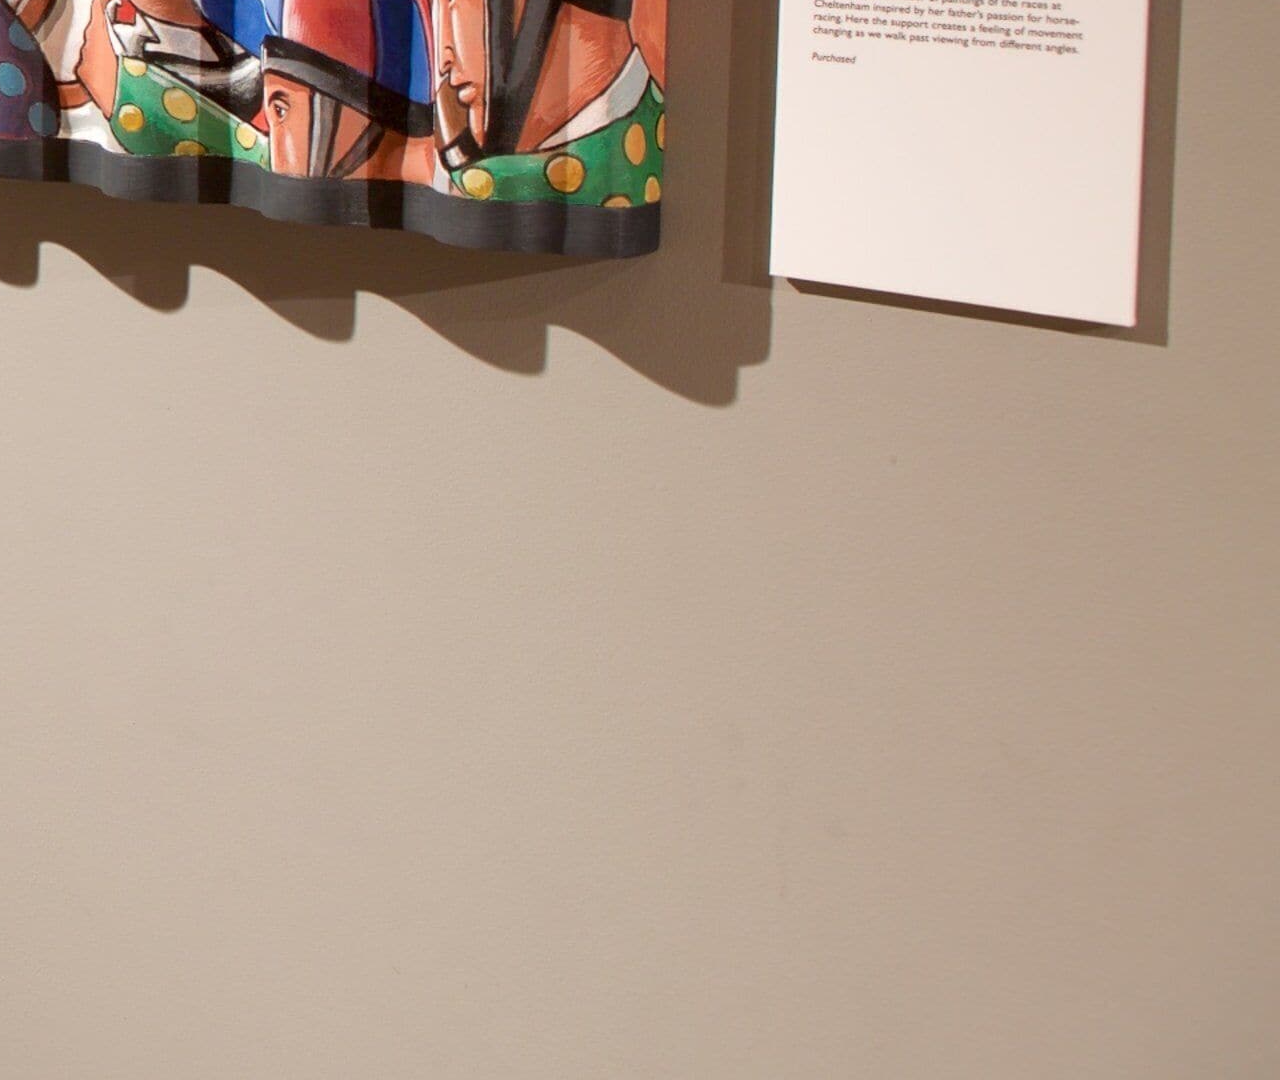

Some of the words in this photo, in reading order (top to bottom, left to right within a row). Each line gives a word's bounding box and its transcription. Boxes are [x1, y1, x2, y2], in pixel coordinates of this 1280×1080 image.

[814, 0, 870, 11] Cheltenham
[873, 3, 911, 14] inspired
[914, 7, 924, 17] by
[928, 8, 945, 16] her
[948, 8, 984, 18] father's
[987, 12, 1024, 22] passion
[1027, 14, 1042, 23] for
[1046, 16, 1080, 25] horse-
[1021, 0, 1048, 9] races
[1052, 2, 1062, 10] at
[813, 26, 852, 38] changing
[856, 29, 865, 37] as
[885, 31, 906, 40] walk
[909, 34, 929, 43] past
[932, 36, 969, 47] viewing
[972, 37, 996, 47] from
[1000, 40, 1042, 51] different
[845, 15, 869, 24] Here
[872, 17, 887, 26] the
[891, 18, 928, 29] support
[932, 21, 966, 31] creates
[970, 24, 976, 32] a
[979, 24, 1011, 36] feeling
[1014, 26, 1025, 35] of
[1028, 29, 1083, 40] movement
[812, 52, 856, 64] Purchased
